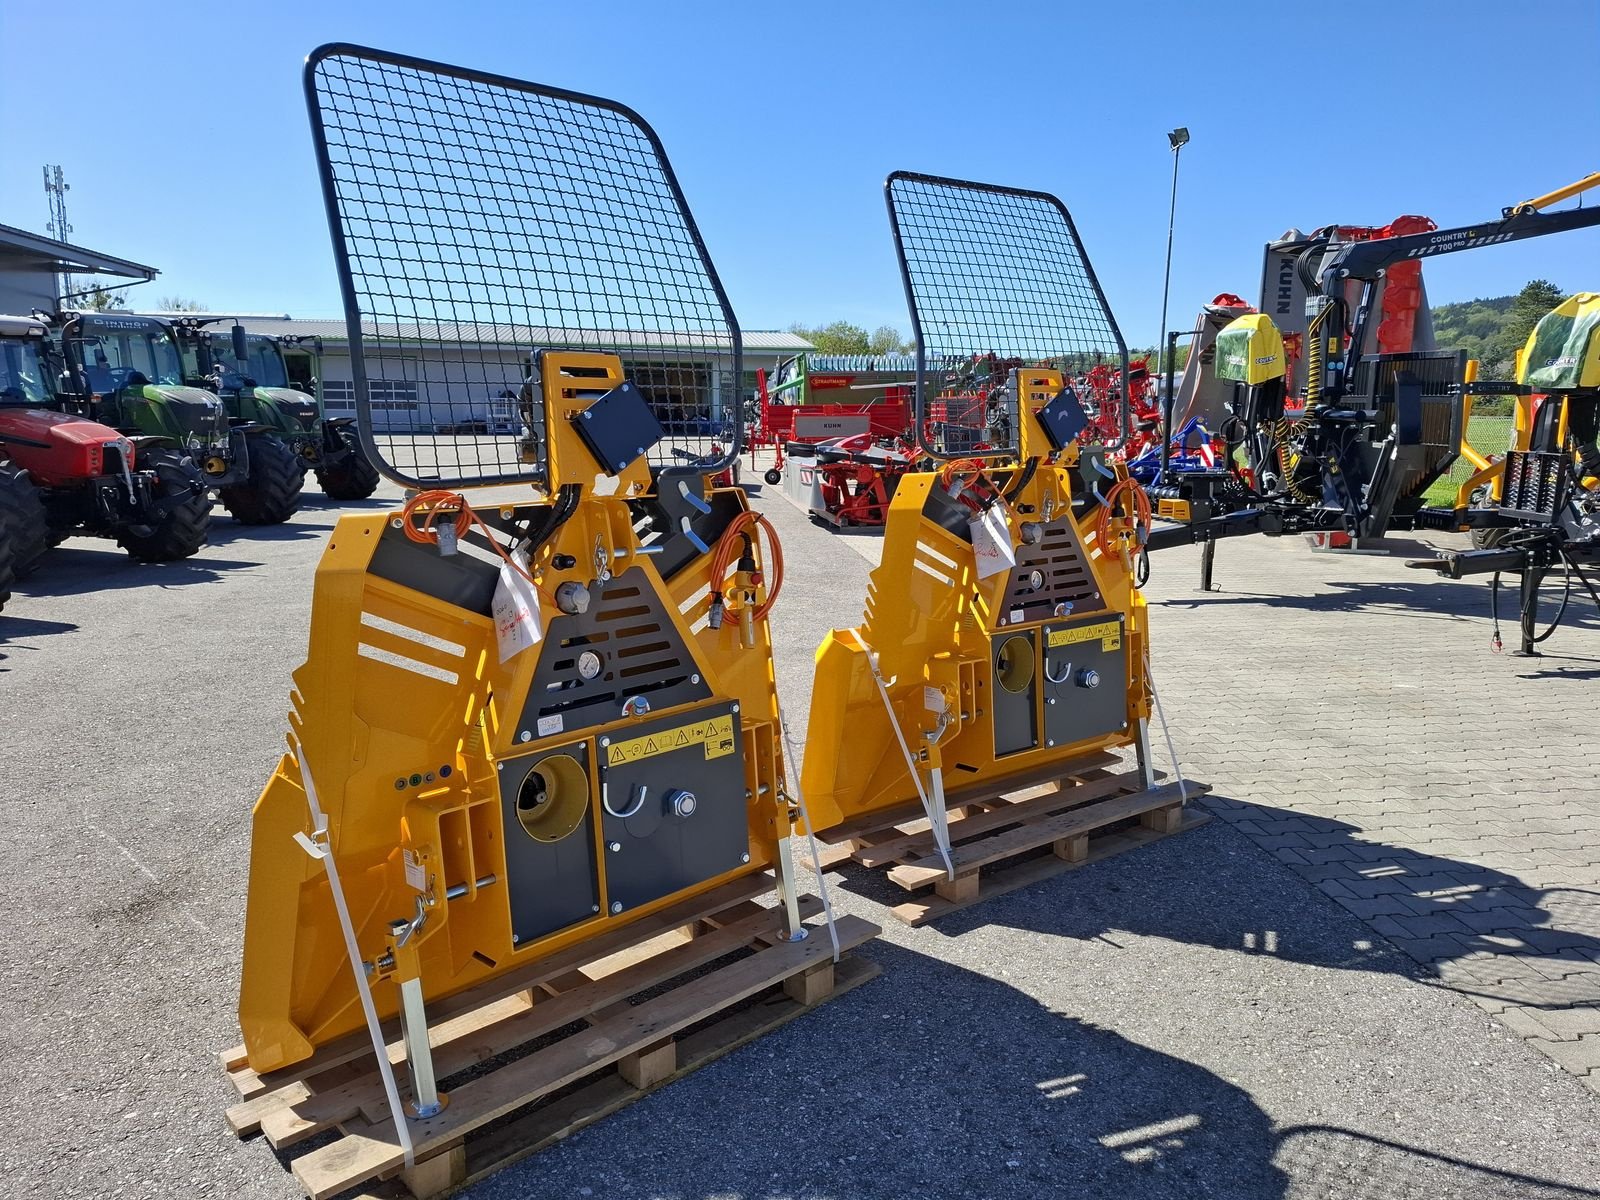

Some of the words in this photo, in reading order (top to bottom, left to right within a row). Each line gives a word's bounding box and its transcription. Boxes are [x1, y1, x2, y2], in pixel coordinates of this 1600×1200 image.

[1430, 231, 1468, 244] COUNTRY
[1438, 243, 1453, 252] 700
[1276, 258, 1294, 314] KUHN
